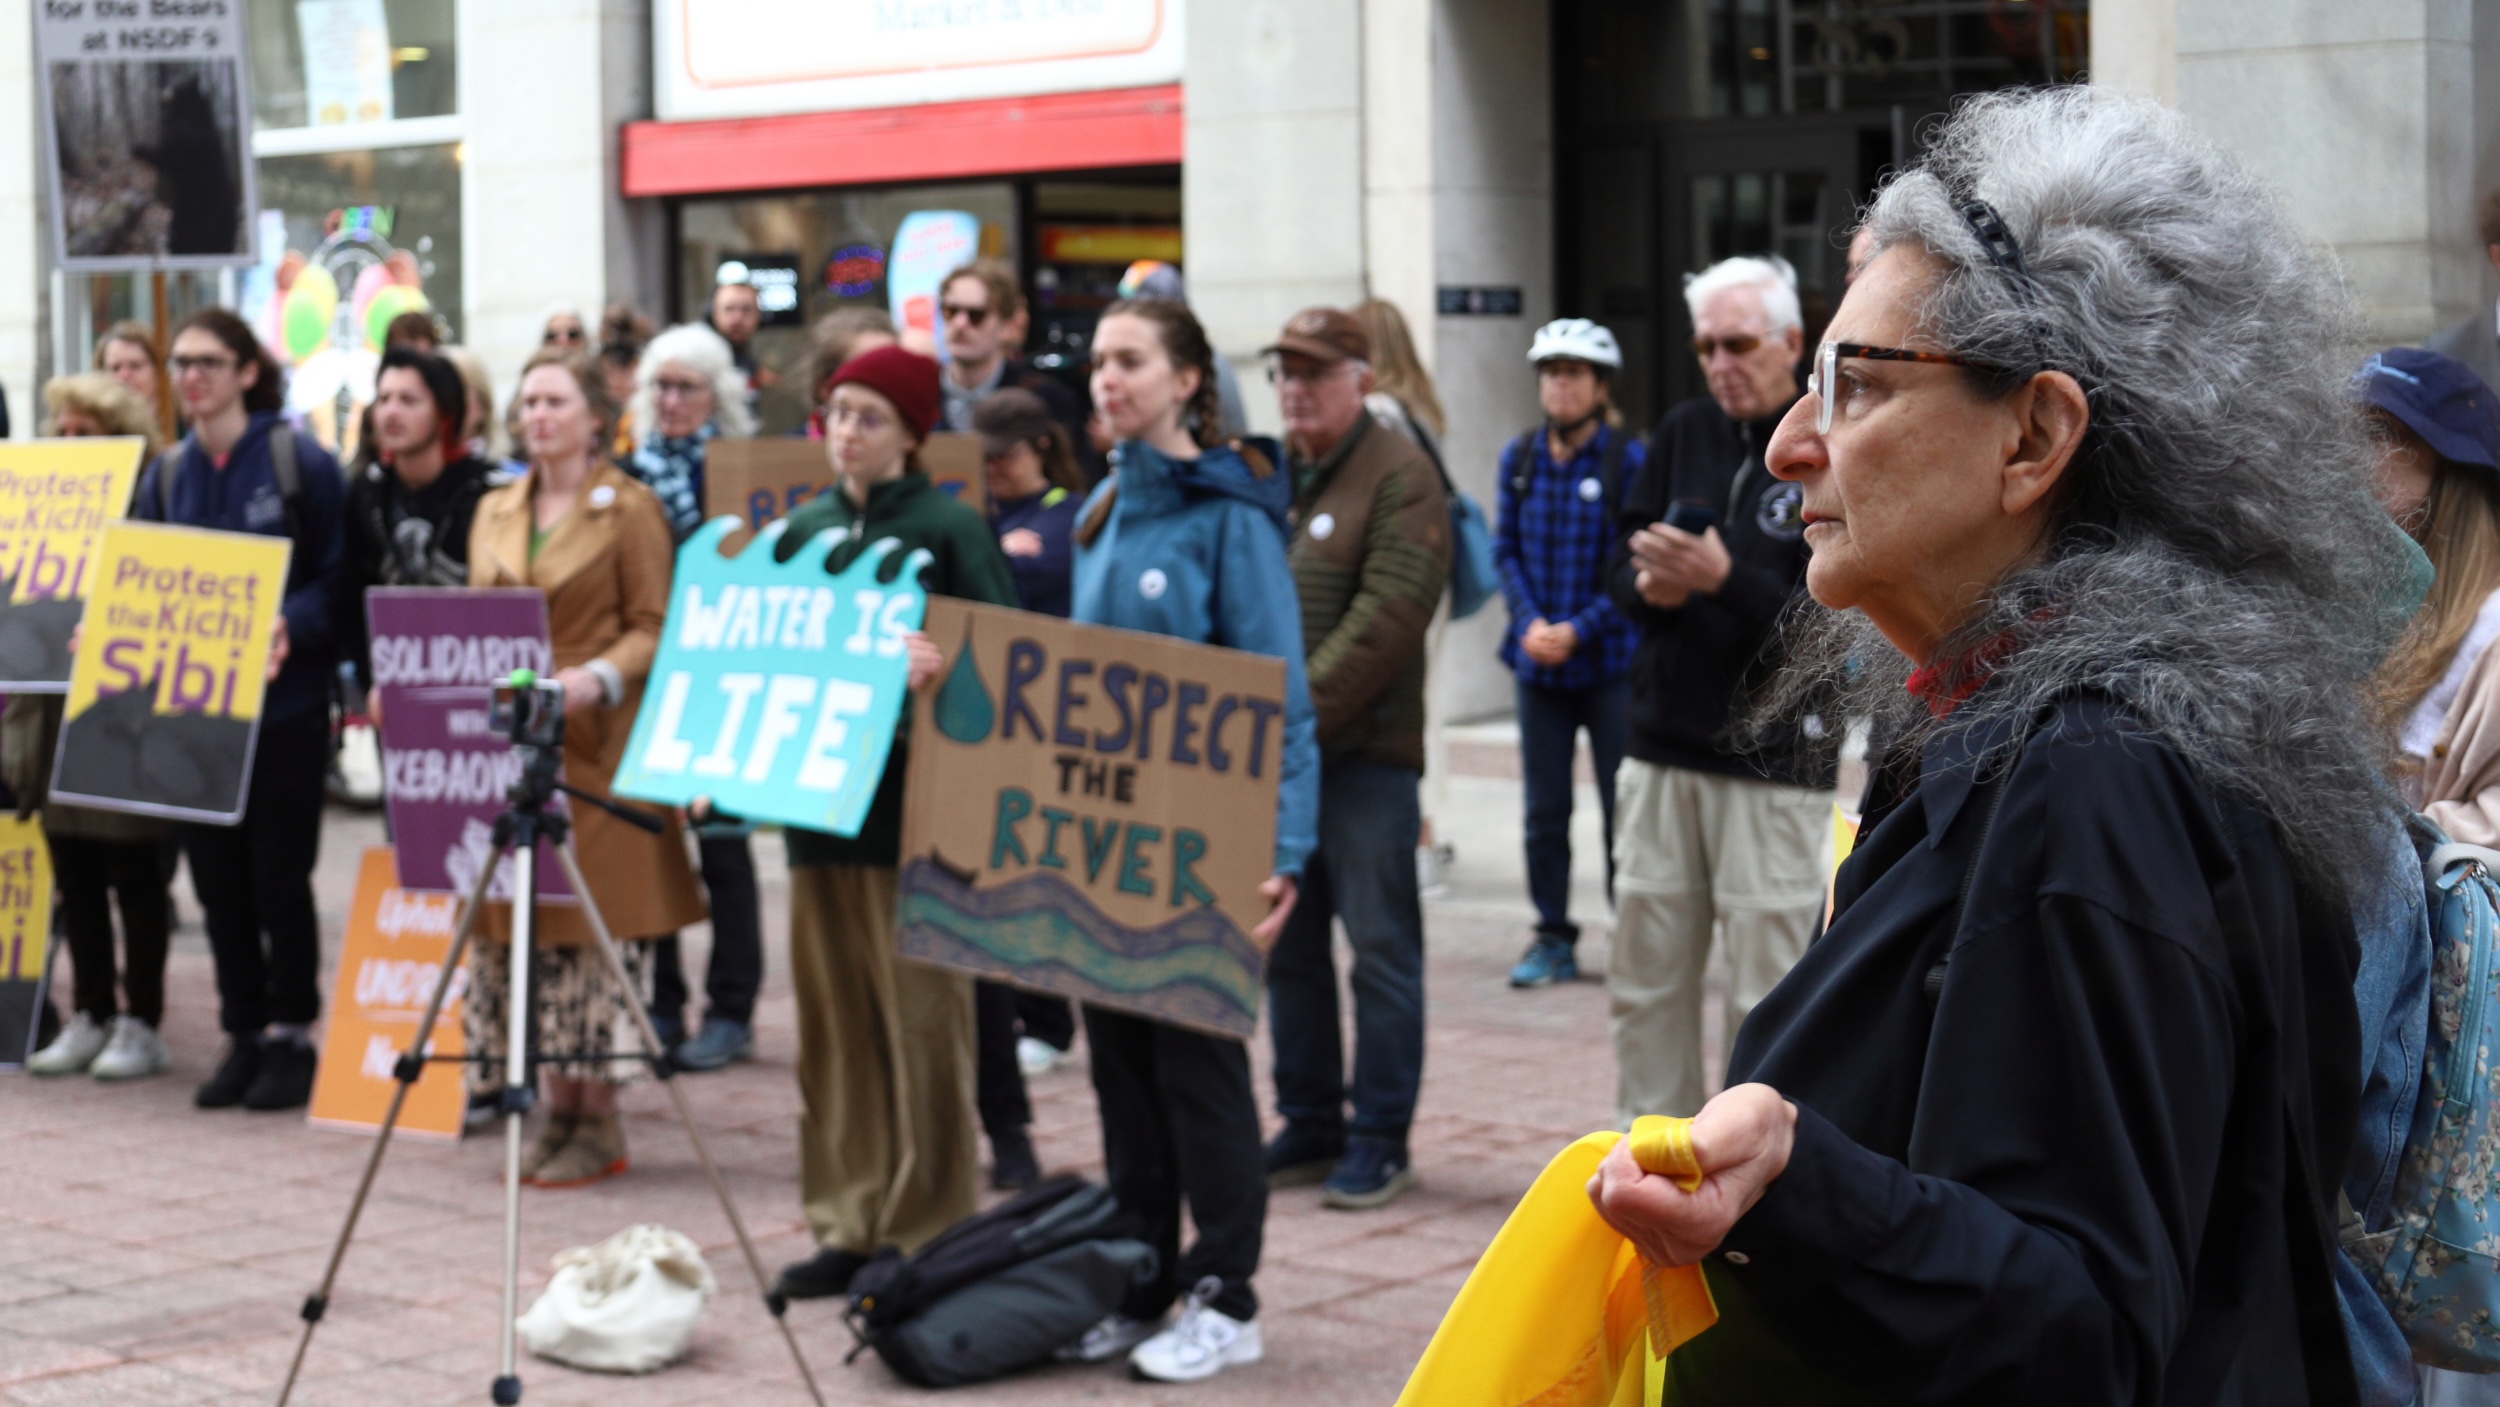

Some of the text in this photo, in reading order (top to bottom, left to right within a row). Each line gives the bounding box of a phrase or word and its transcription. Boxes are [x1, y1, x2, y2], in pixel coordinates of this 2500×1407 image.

[82, 31, 107, 50] at
[113, 555, 260, 600] Protect
[107, 600, 255, 643] the Kichi
[679, 584, 915, 657] WATER IS
[97, 637, 243, 716] Sibi
[372, 634, 551, 686] SOLIDARITY
[642, 670, 874, 791] LIFE
[1002, 637, 1280, 779] RESPECT
[1055, 754, 1138, 803] THE
[989, 787, 1216, 907] RIVER
